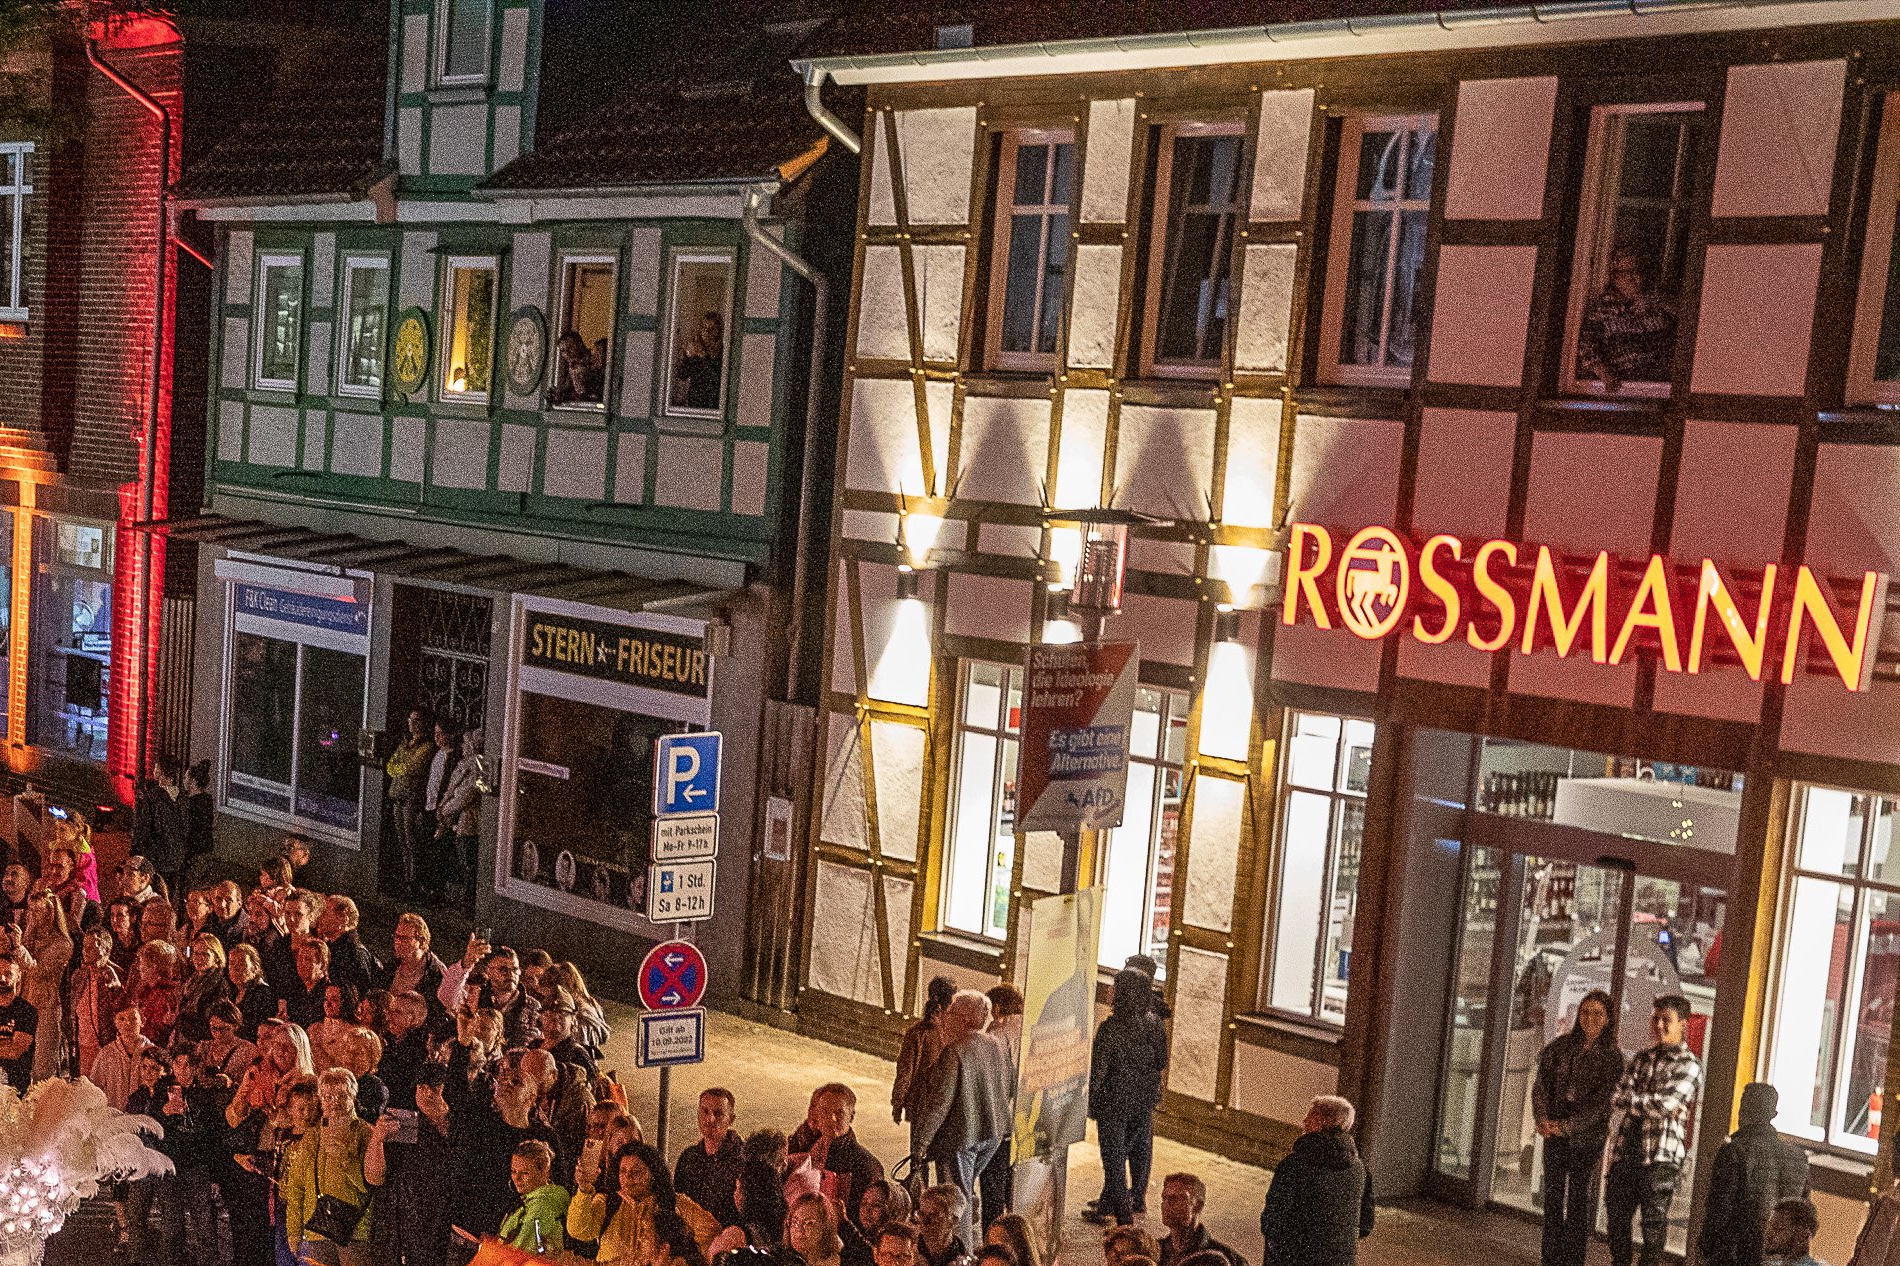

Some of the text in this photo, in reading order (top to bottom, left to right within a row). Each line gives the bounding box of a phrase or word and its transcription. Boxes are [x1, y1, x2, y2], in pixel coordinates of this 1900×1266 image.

[1281, 522, 1878, 692] ROSSMANN
[531, 623, 706, 686] STERN FRISEUR
[1032, 669, 1115, 691] die Ideologie
[1031, 691, 1084, 708] lehren?
[1049, 730, 1122, 752] Es gibt eine
[667, 745, 701, 805] P
[1082, 787, 1114, 808] AfD
[661, 823, 712, 838] mit Parkschein
[663, 840, 685, 853] Mo-Fr
[679, 873, 706, 888] 1 Std.
[658, 899, 671, 913] Sa
[658, 1025, 686, 1035] Gilt ab
